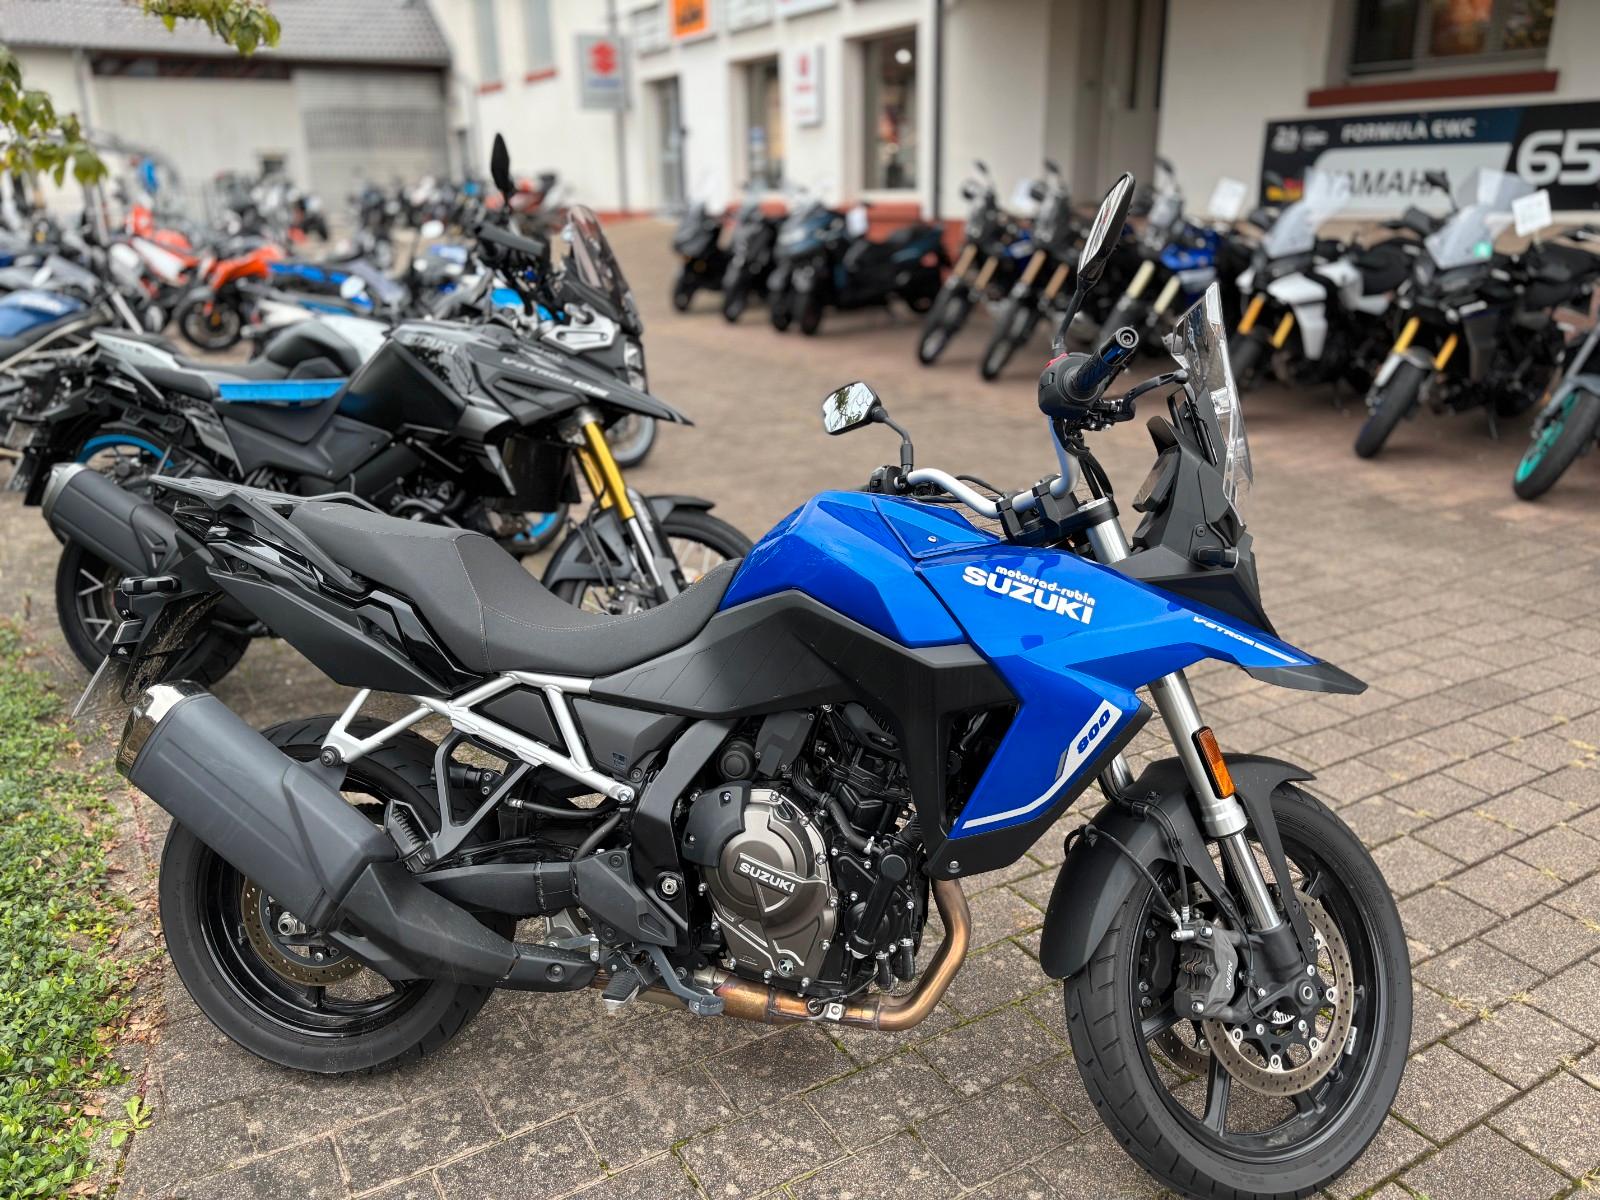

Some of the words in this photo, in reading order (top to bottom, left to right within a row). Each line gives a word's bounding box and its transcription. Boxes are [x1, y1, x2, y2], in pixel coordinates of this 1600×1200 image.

[1341, 121, 1428, 143] FORMULA
[1430, 117, 1476, 139] EWC
[1515, 127, 1600, 187] 65
[1324, 168, 1447, 196] AMAH
[962, 565, 1094, 625] SUZUKI
[995, 565, 1096, 606] motorrad-rubin
[1077, 708, 1111, 755] 800
[739, 861, 797, 894] SUZUKI
